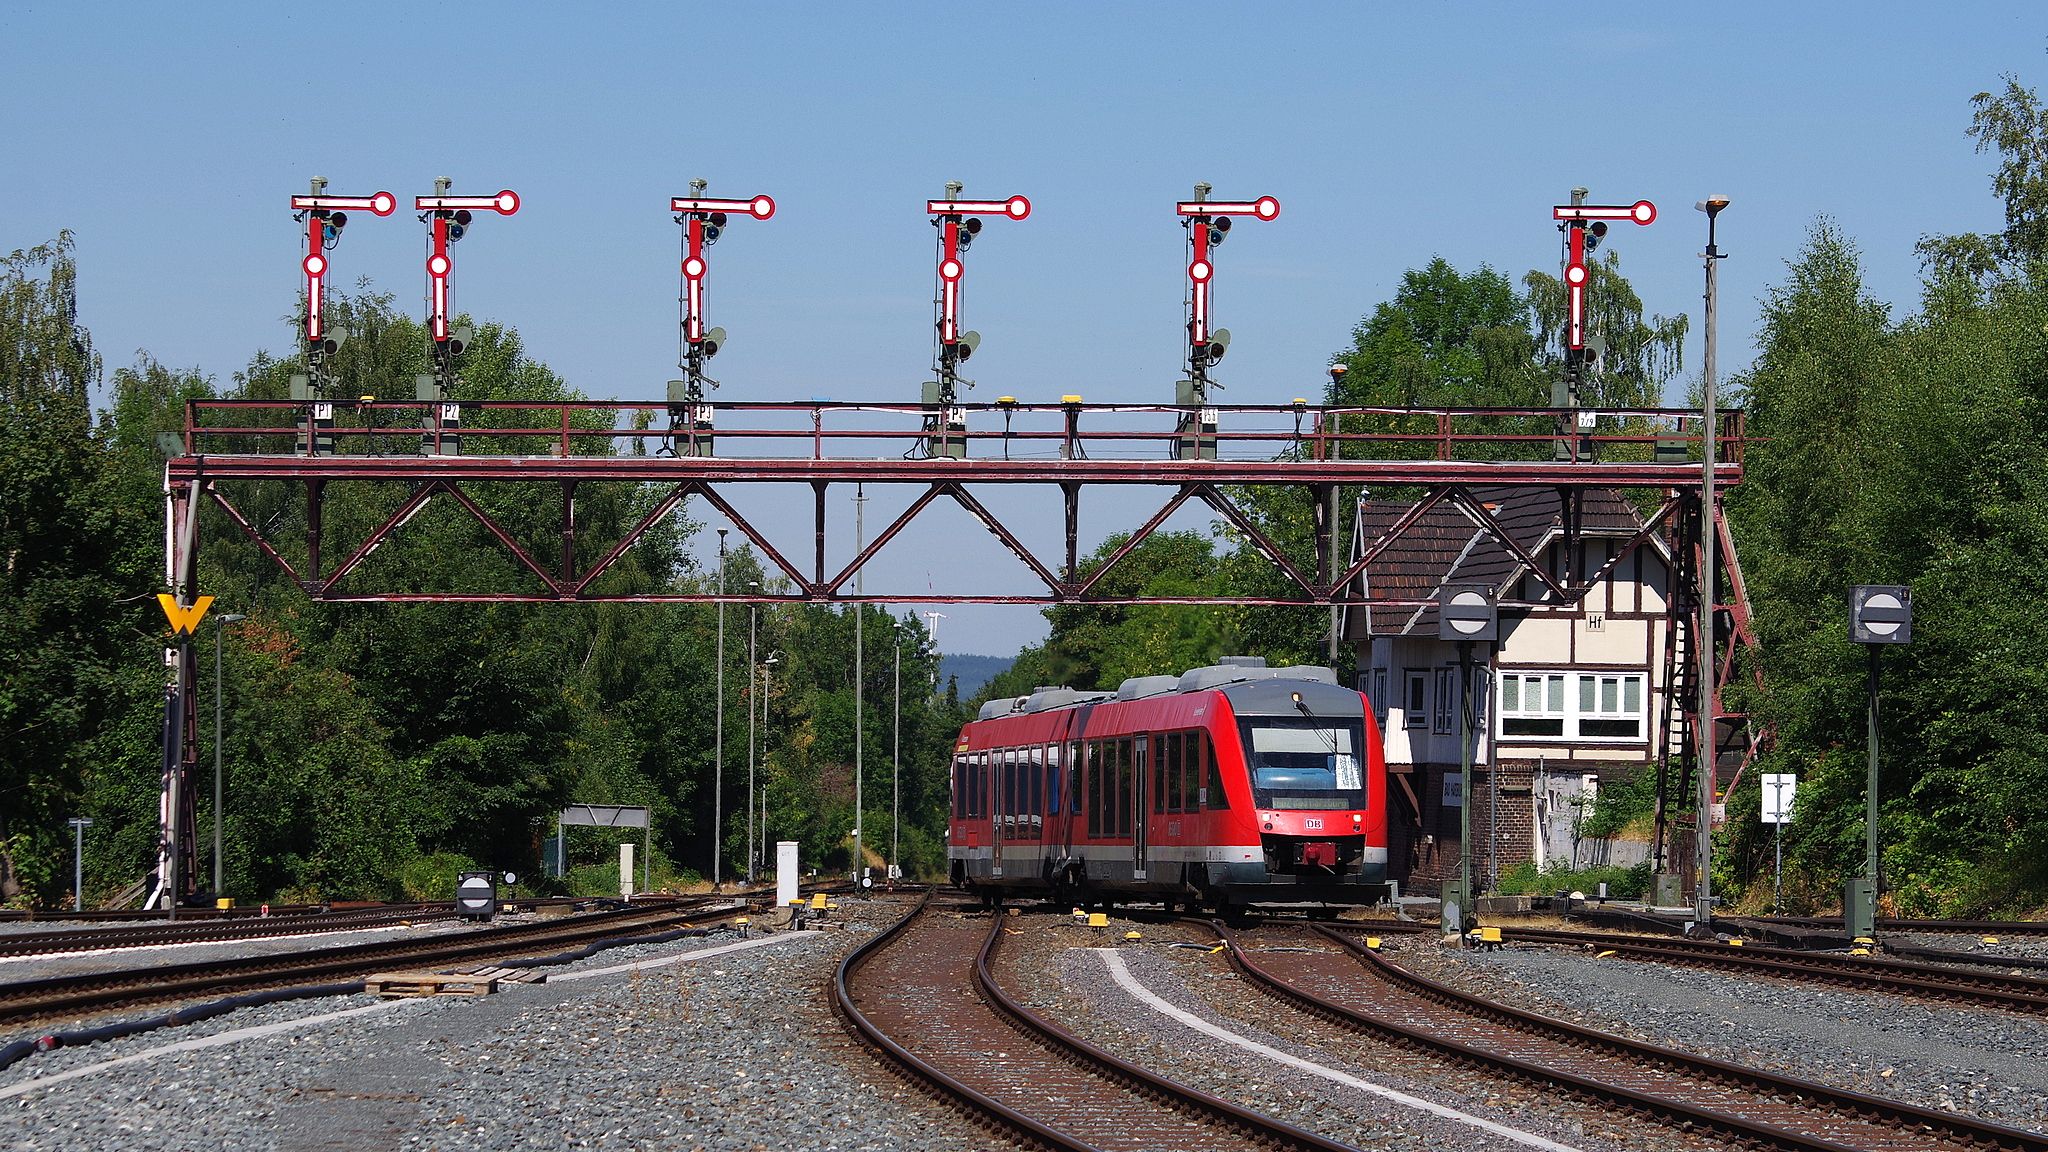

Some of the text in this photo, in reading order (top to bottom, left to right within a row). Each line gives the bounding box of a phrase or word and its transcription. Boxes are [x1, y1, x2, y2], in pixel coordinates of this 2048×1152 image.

[318, 404, 329, 417] P1
[446, 404, 457, 418] P2
[700, 405, 711, 419] P3
[952, 407, 963, 421] P4
[156, 593, 216, 635] W
[1589, 615, 1602, 629] Hf
[1306, 820, 1322, 829] DB
